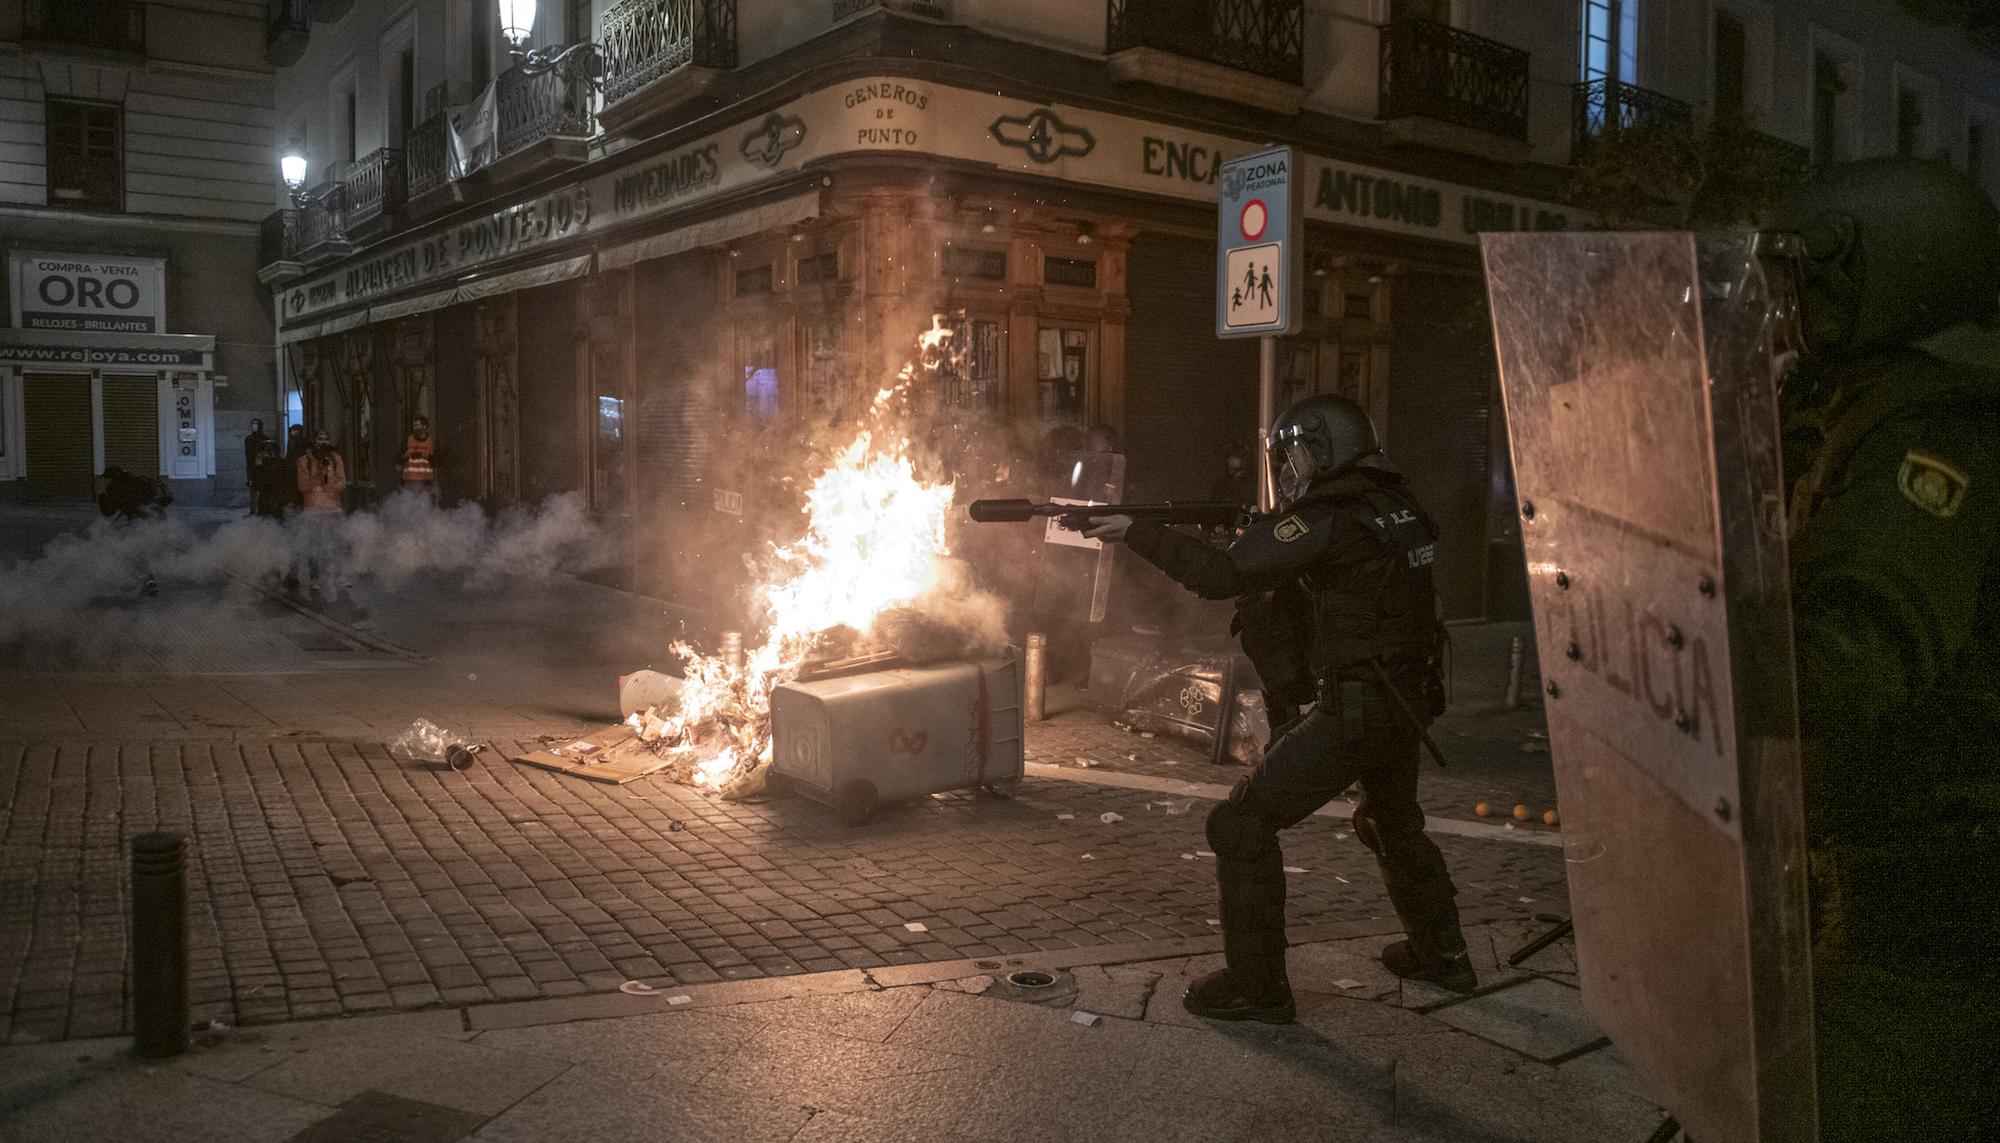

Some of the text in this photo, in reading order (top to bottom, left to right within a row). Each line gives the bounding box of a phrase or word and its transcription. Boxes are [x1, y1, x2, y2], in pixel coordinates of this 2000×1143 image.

[845, 83, 928, 109] GENEROS
[877, 109, 893, 119] DE
[858, 128, 917, 145] PUNTO
[614, 142, 718, 213] NOVEDADES
[1246, 160, 1287, 181] ZONA
[1246, 177, 1286, 192] PEATONAL
[1314, 166, 1441, 228] ANTONIO
[424, 234, 451, 273] DE
[458, 187, 591, 261] PONTEJOS
[38, 261, 92, 273] COMPRA
[100, 265, 139, 276] VENTA
[38, 275, 140, 310] ORO
[32, 318, 77, 329] RELOJES
[84, 320, 148, 332] BRILLANTES
